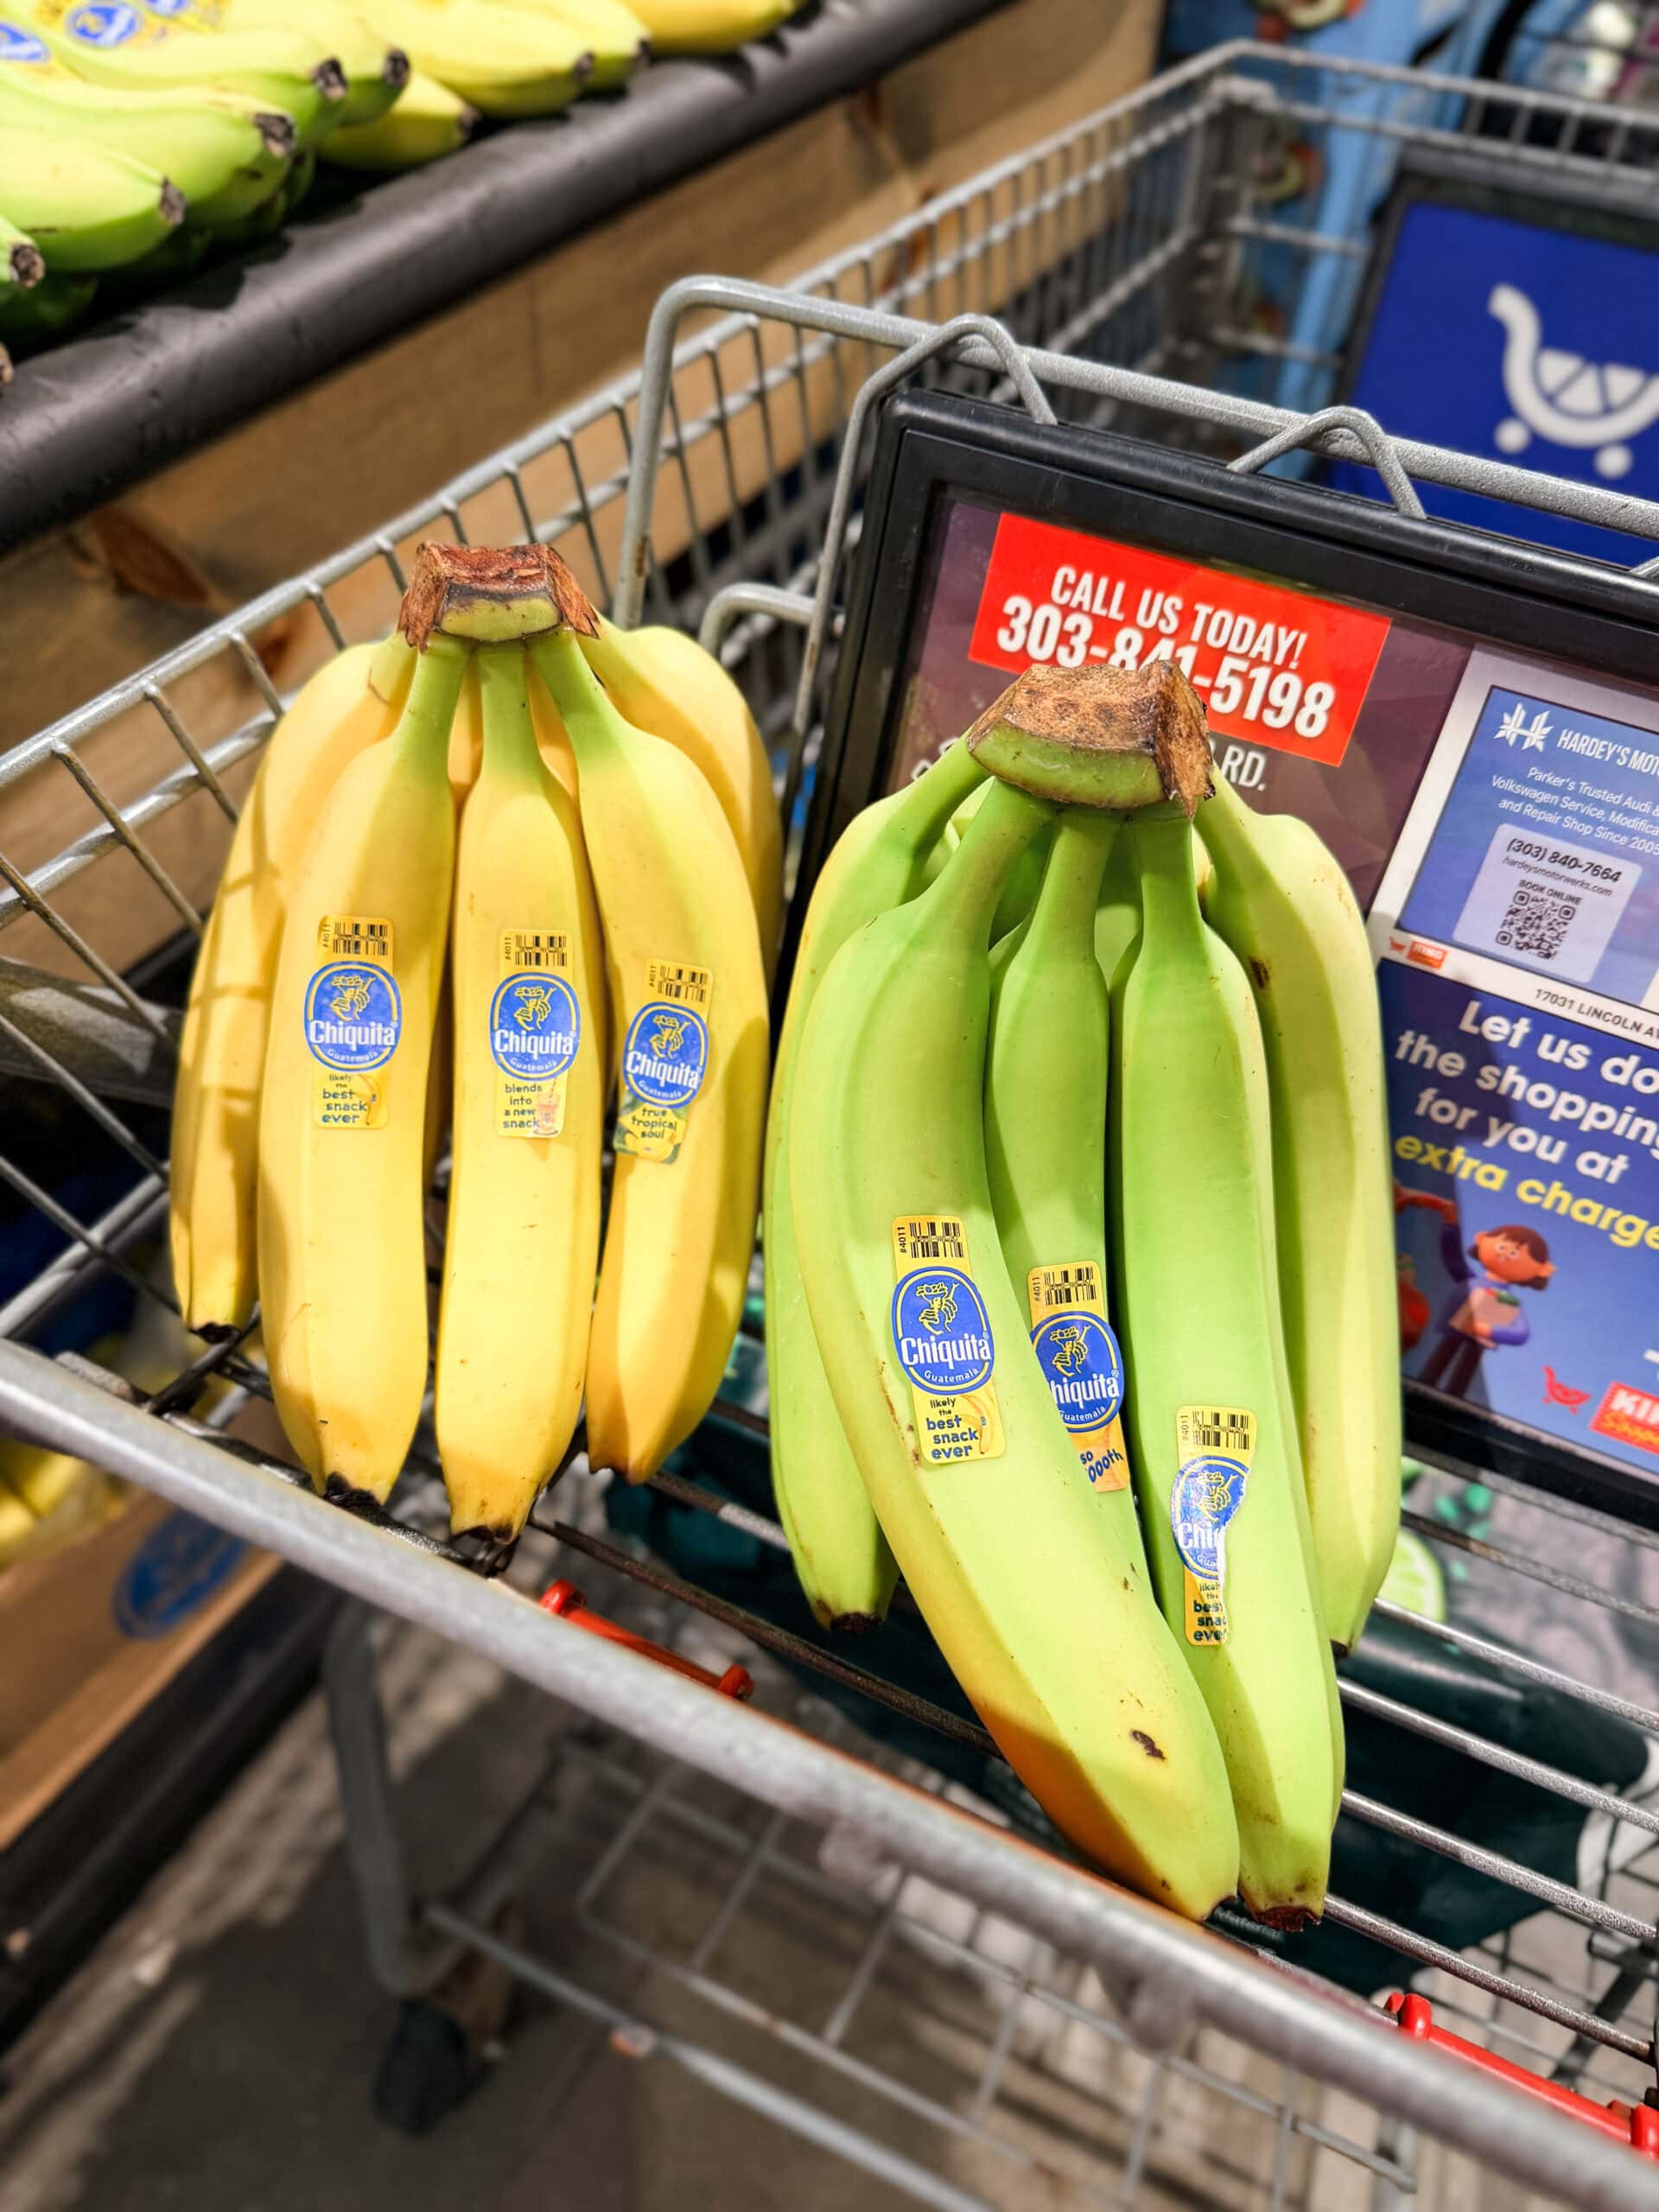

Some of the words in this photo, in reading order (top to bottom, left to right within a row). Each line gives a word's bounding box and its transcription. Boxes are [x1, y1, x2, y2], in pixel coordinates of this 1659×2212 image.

[1051, 565, 1126, 621] CALL
[1136, 588, 1183, 635] US
[1190, 603, 1308, 669] TODAY!
[1557, 728, 1630, 766] HARDEY'S
[1628, 750, 1659, 775] MOT
[1492, 774, 1559, 804] Volkswagen
[1560, 797, 1605, 822] Service,
[1528, 767, 1575, 791] Parker's
[1579, 781, 1622, 804] Trusted
[1623, 796, 1652, 813] Audi
[1498, 799, 1522, 813] and
[1522, 804, 1561, 826] Repair
[1561, 816, 1593, 836] Shop
[1594, 827, 1628, 845] Since
[1507, 838, 1548, 861] (303)
[1548, 851, 1622, 882] 840-7664
[1518, 880, 1547, 893] BOOK
[1547, 888, 1583, 905] ONLINE
[1535, 988, 1574, 1011] 17031
[1577, 1002, 1643, 1033] LINCOLN
[310, 1020, 395, 1051] Chiquita
[494, 1029, 573, 1060] Chiquita
[327, 1048, 378, 1063] Guatemala
[1395, 1029, 1466, 1078] the
[1459, 1000, 1531, 1048] Let
[1536, 1033, 1593, 1071] us
[1600, 1054, 1659, 1094] do
[509, 1057, 557, 1071] Guatemala
[626, 1050, 699, 1090] Chiquita
[322, 1089, 355, 1099] best
[505, 1084, 543, 1093] blends
[638, 1079, 683, 1099] Guatemala
[326, 1101, 368, 1111] snack
[509, 1096, 532, 1105] into
[321, 1114, 359, 1123] ever
[513, 1108, 536, 1116] new
[632, 1116, 677, 1130] tropical
[642, 1107, 666, 1117] true
[503, 1119, 539, 1128] snack
[640, 1128, 664, 1139] soul
[1414, 1087, 1478, 1131] for
[1481, 1116, 1568, 1165] you
[1575, 1150, 1629, 1185] at
[1394, 1135, 1509, 1192] extra
[898, 1226, 906, 1254] #4011
[901, 1333, 991, 1370] Chiquita
[924, 1368, 979, 1383] Guatemala
[1050, 1372, 1120, 1409] hiquita
[930, 1396, 957, 1408] likely
[926, 1414, 963, 1431] best
[932, 1428, 979, 1445] snack
[931, 1444, 973, 1459] ever
